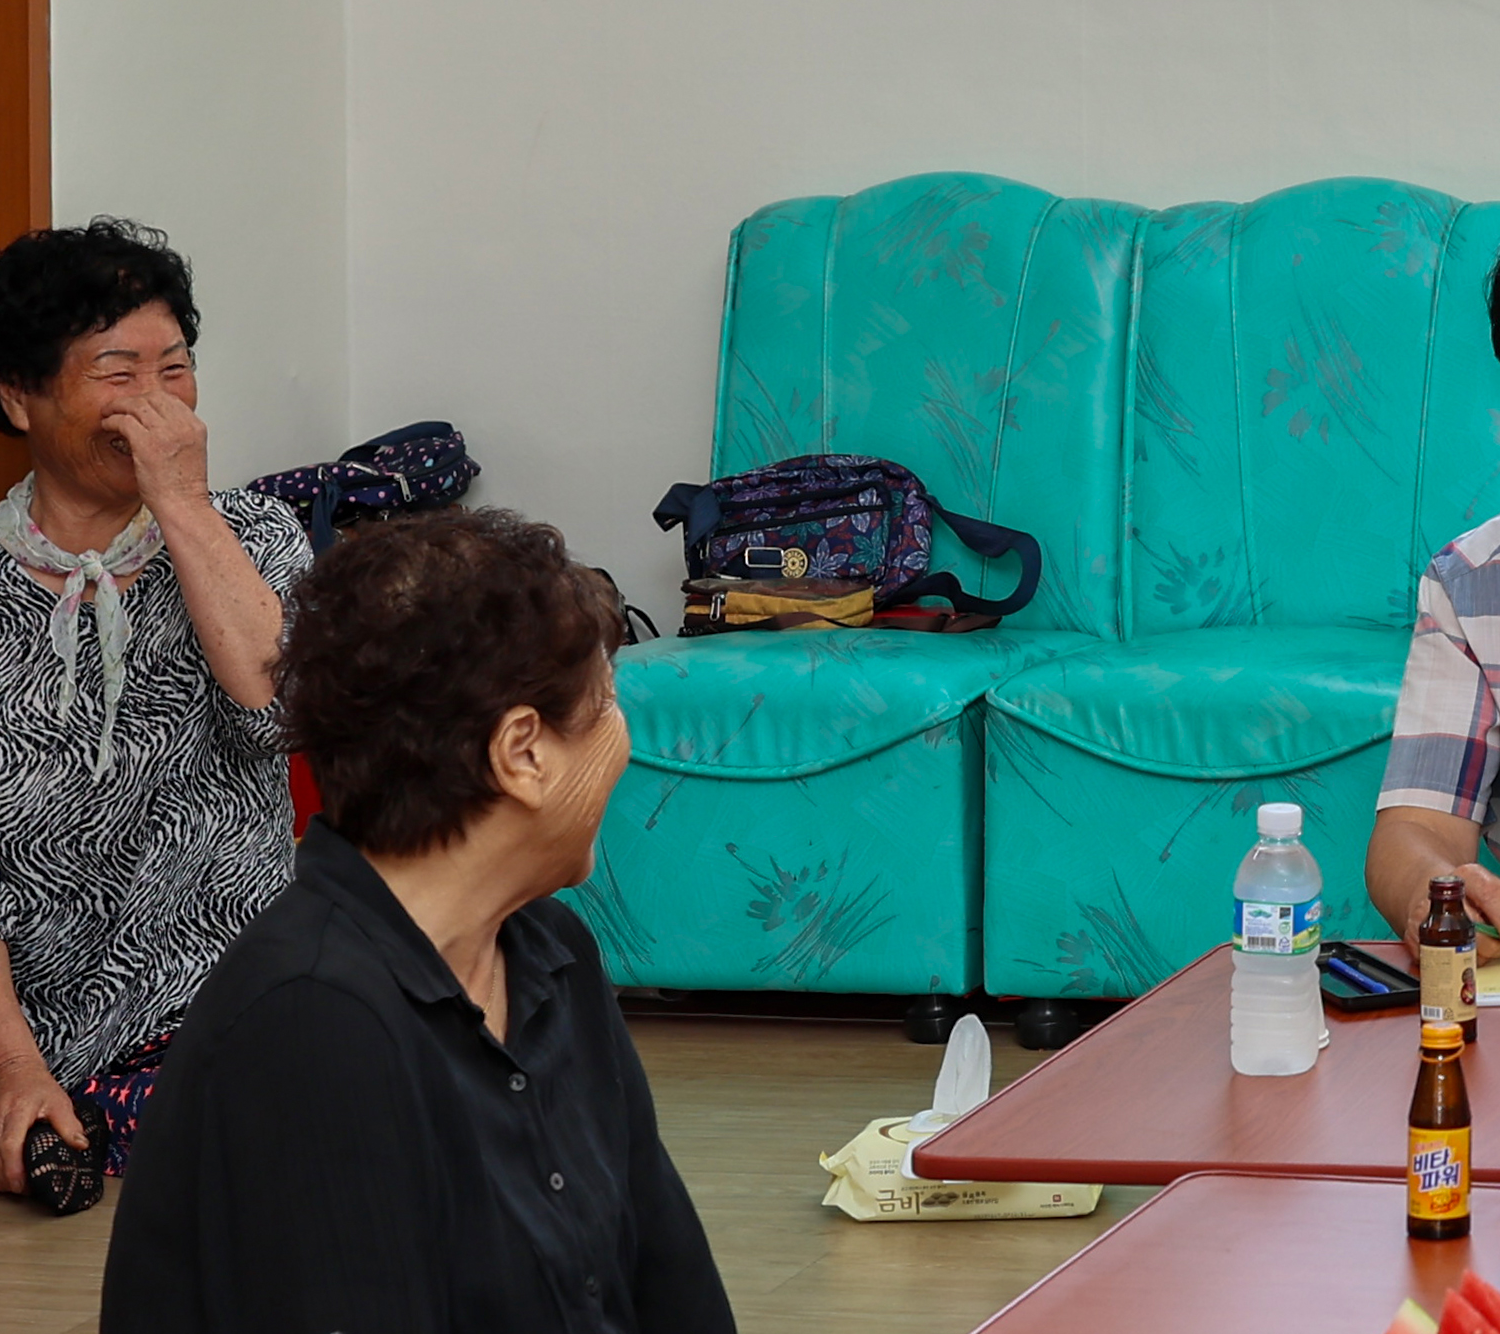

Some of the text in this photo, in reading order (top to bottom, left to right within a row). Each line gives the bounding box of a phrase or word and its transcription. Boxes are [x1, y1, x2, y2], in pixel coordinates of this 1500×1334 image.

[1412, 1147, 1450, 1174] 비타
[1419, 1162, 1460, 1192] 파워
[876, 1189, 921, 1215] 금비
